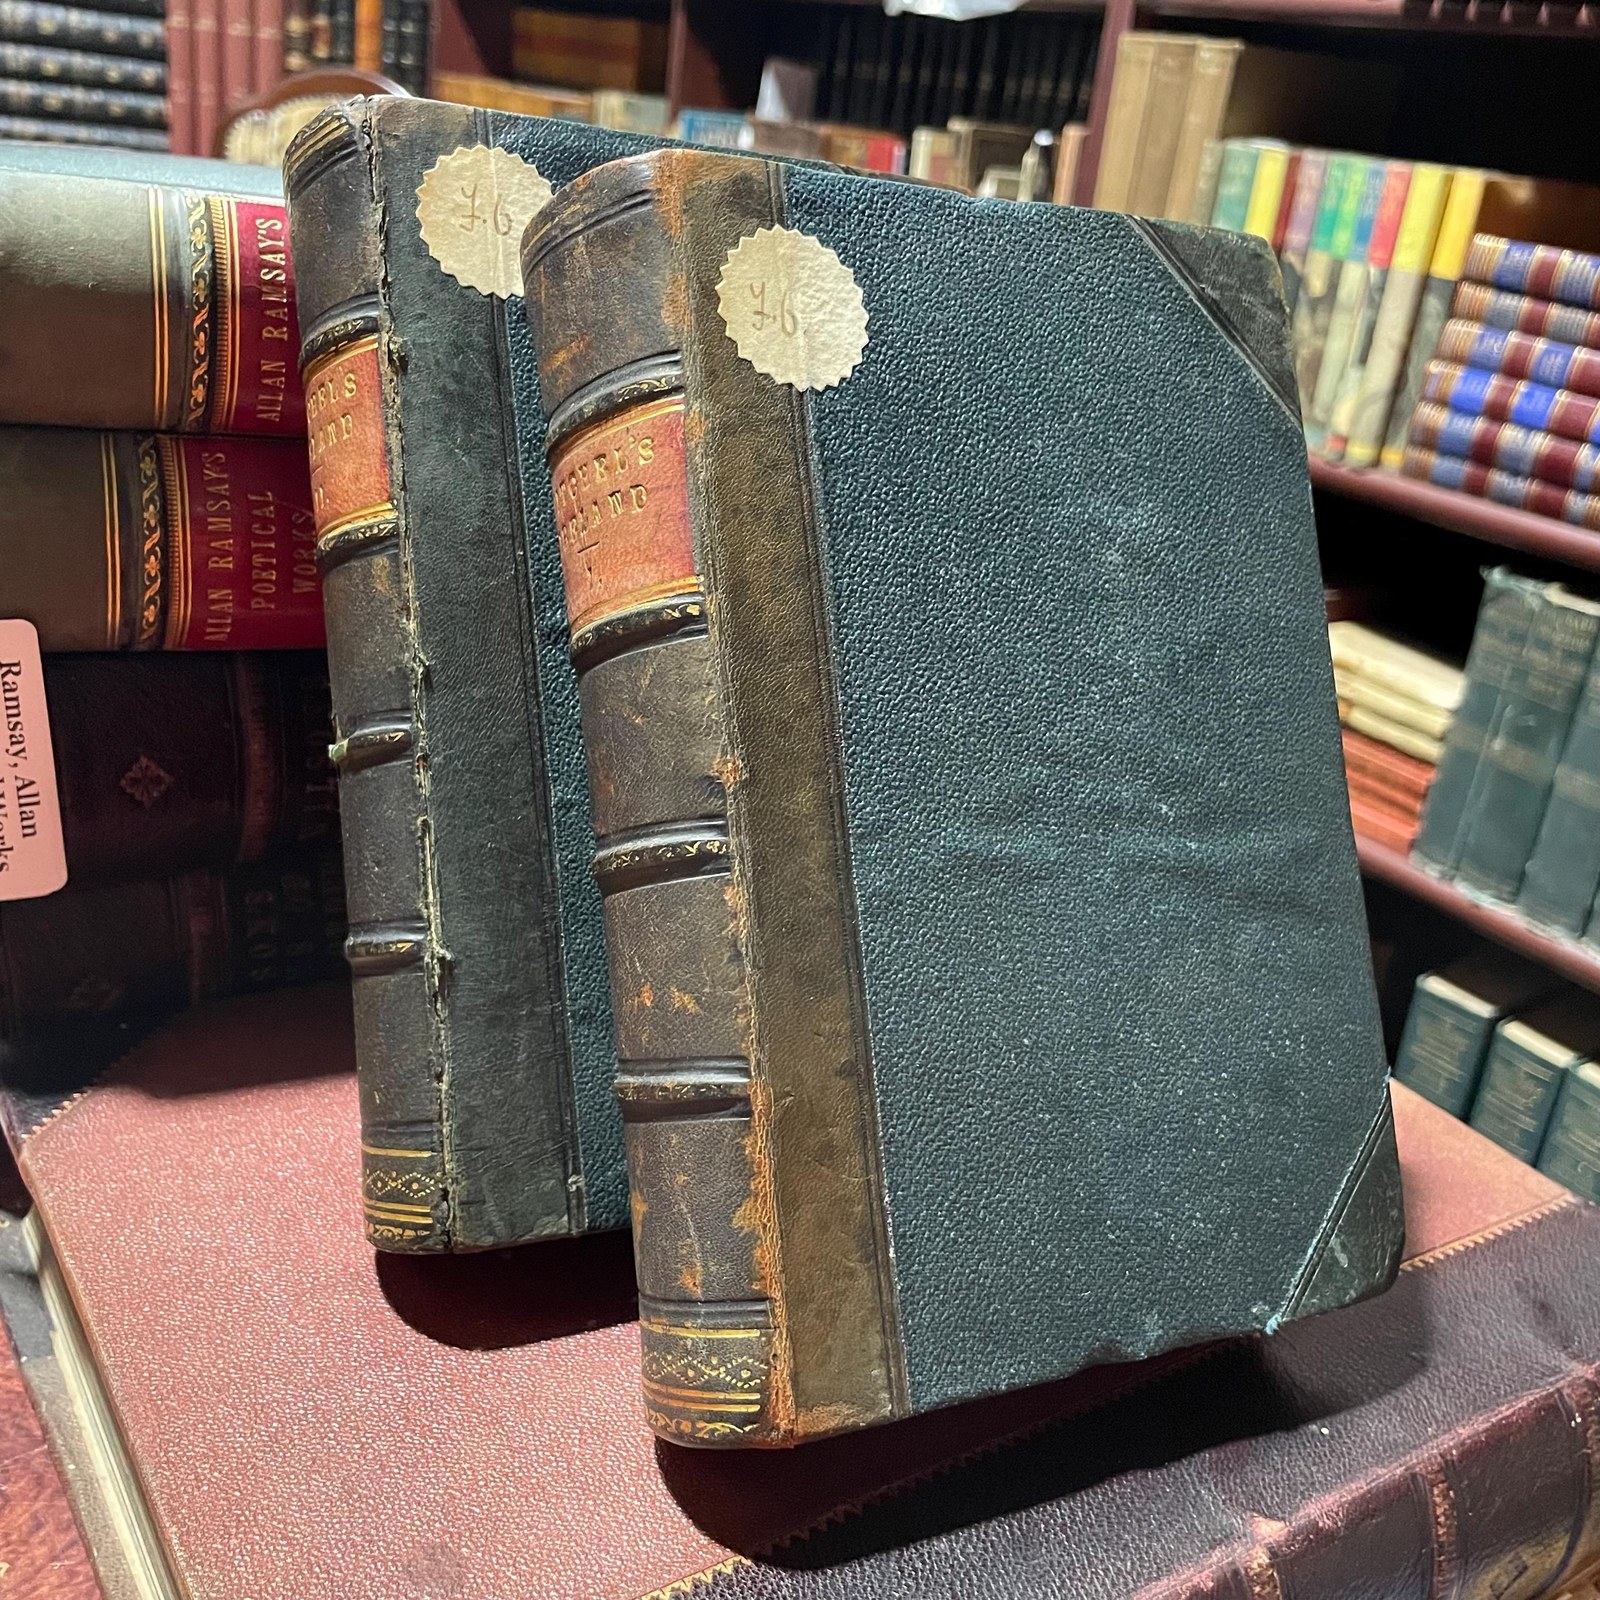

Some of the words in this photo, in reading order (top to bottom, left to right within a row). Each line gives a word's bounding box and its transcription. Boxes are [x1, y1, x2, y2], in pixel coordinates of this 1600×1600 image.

[255, 218, 288, 342] RAMSAY'S
[256, 359, 287, 422] ALLAN
[202, 452, 234, 571] RAMSAY'S
[247, 490, 278, 610] POETICAL
[291, 510, 318, 594] WORKS
[203, 587, 234, 642] ALLAN
[0, 660, 28, 768] Ramsay,
[15, 775, 42, 839] Allan
